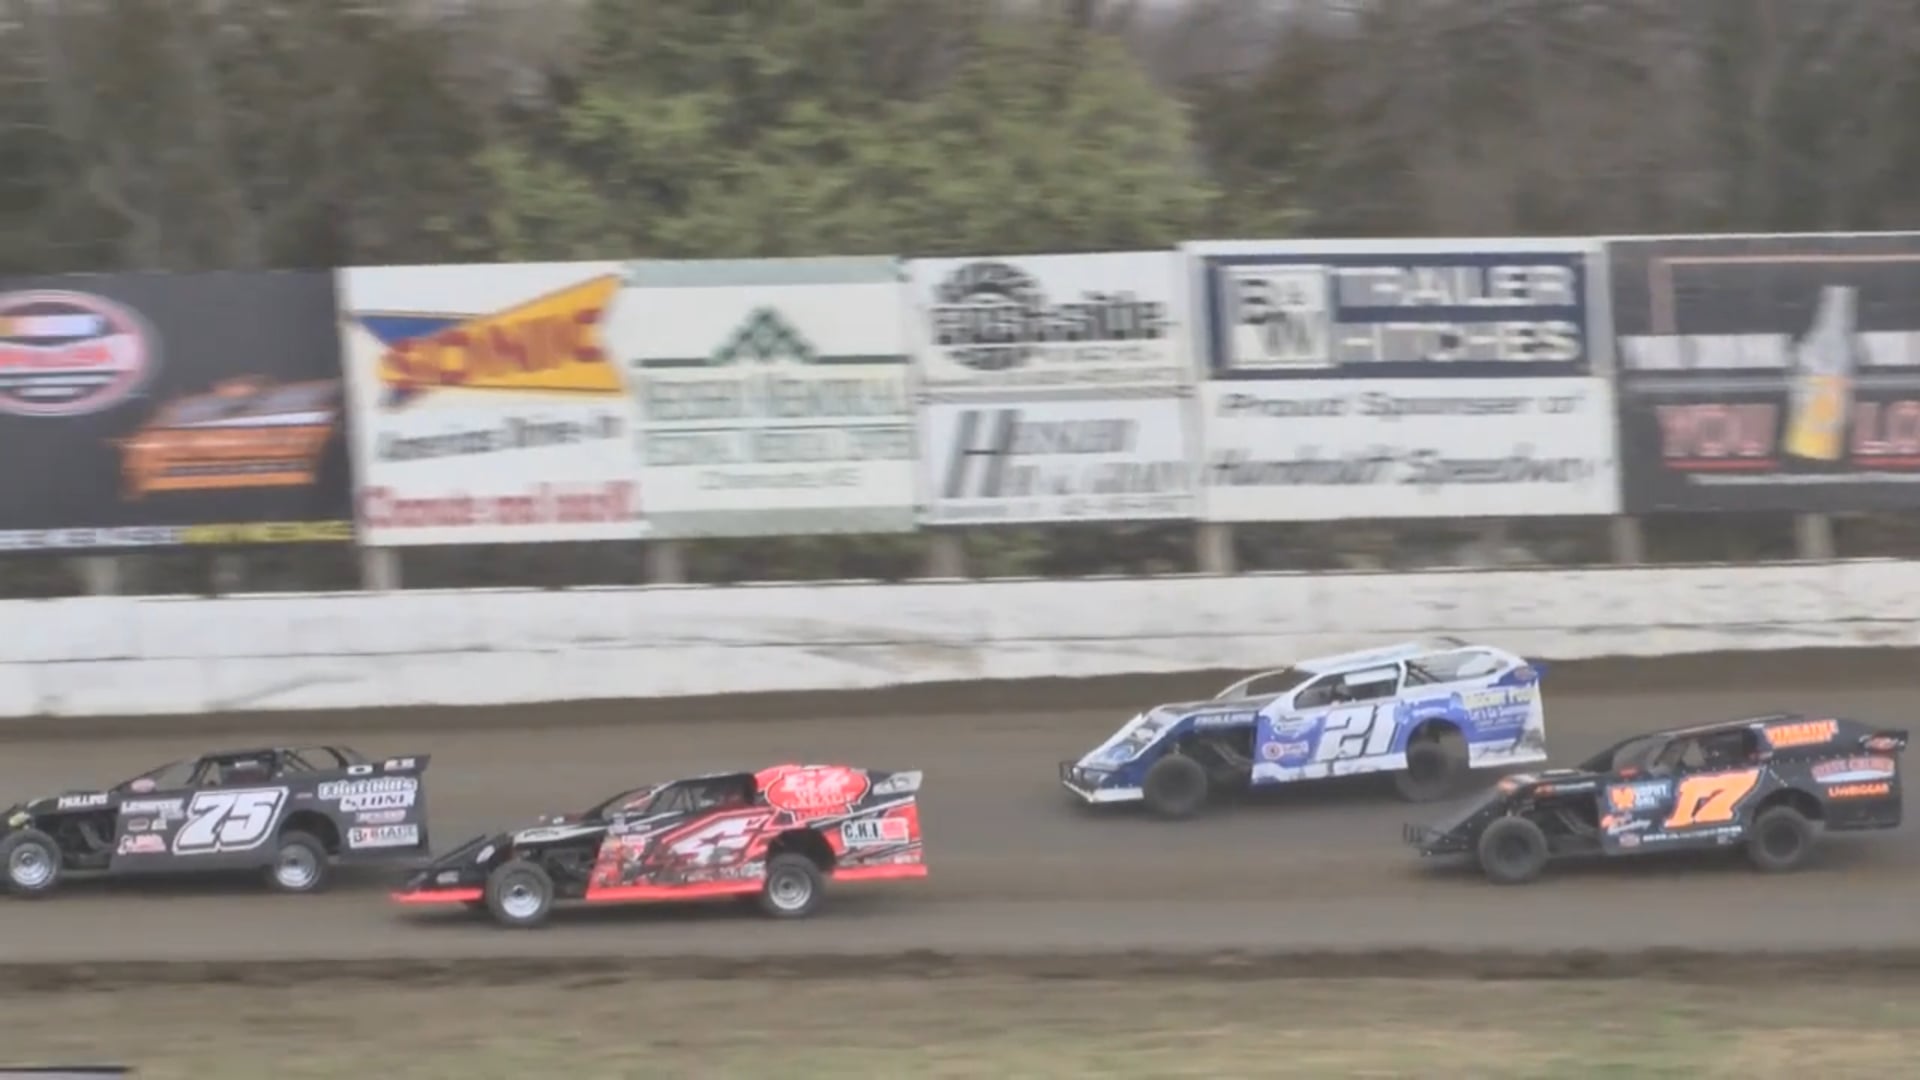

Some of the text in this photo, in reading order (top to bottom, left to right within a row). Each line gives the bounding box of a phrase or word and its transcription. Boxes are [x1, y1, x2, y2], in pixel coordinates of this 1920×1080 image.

[1334, 264, 1575, 306] TRAILER
[1334, 319, 1580, 362] HITCHES
[1315, 703, 1397, 762] 21
[172, 787, 288, 855] 75
[1662, 769, 1759, 829] 17
